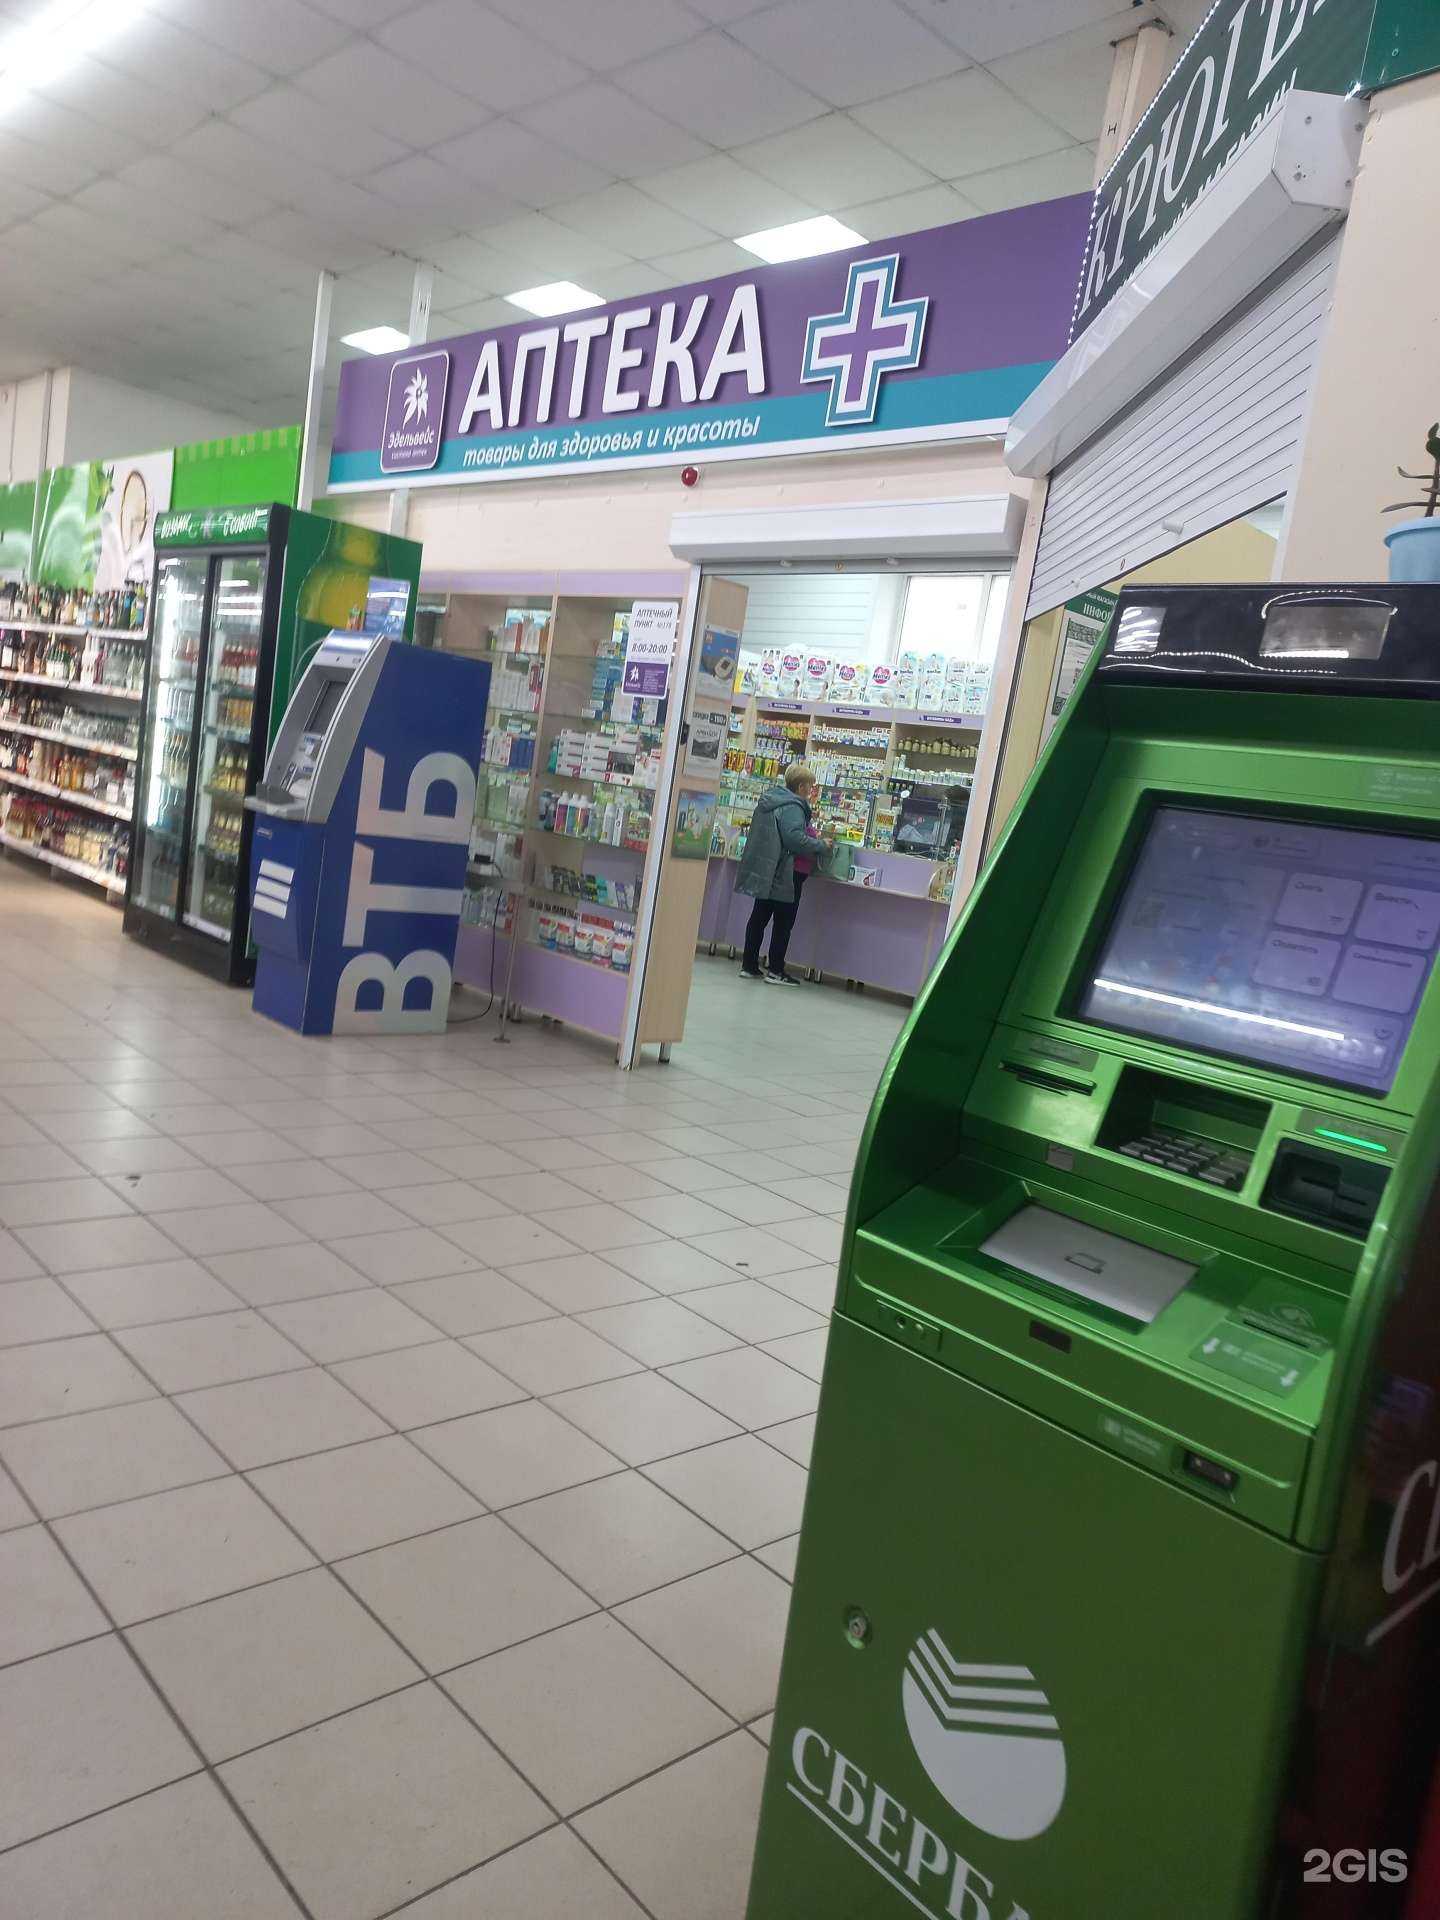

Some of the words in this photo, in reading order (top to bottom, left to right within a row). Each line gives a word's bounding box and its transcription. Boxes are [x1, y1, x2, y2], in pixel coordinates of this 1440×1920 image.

[458, 284, 766, 434] АПТЕКА
[462, 441, 526, 467] товары
[527, 435, 557, 461] для
[560, 431, 643, 460] здоровья
[646, 430, 660, 448] и
[663, 415, 761, 450] красоты
[636, 607, 673, 619] АПТЕЧНЫЙ
[331, 746, 477, 1036] ВТБ
[791, 1725, 1032, 1920] СБЕРБ
